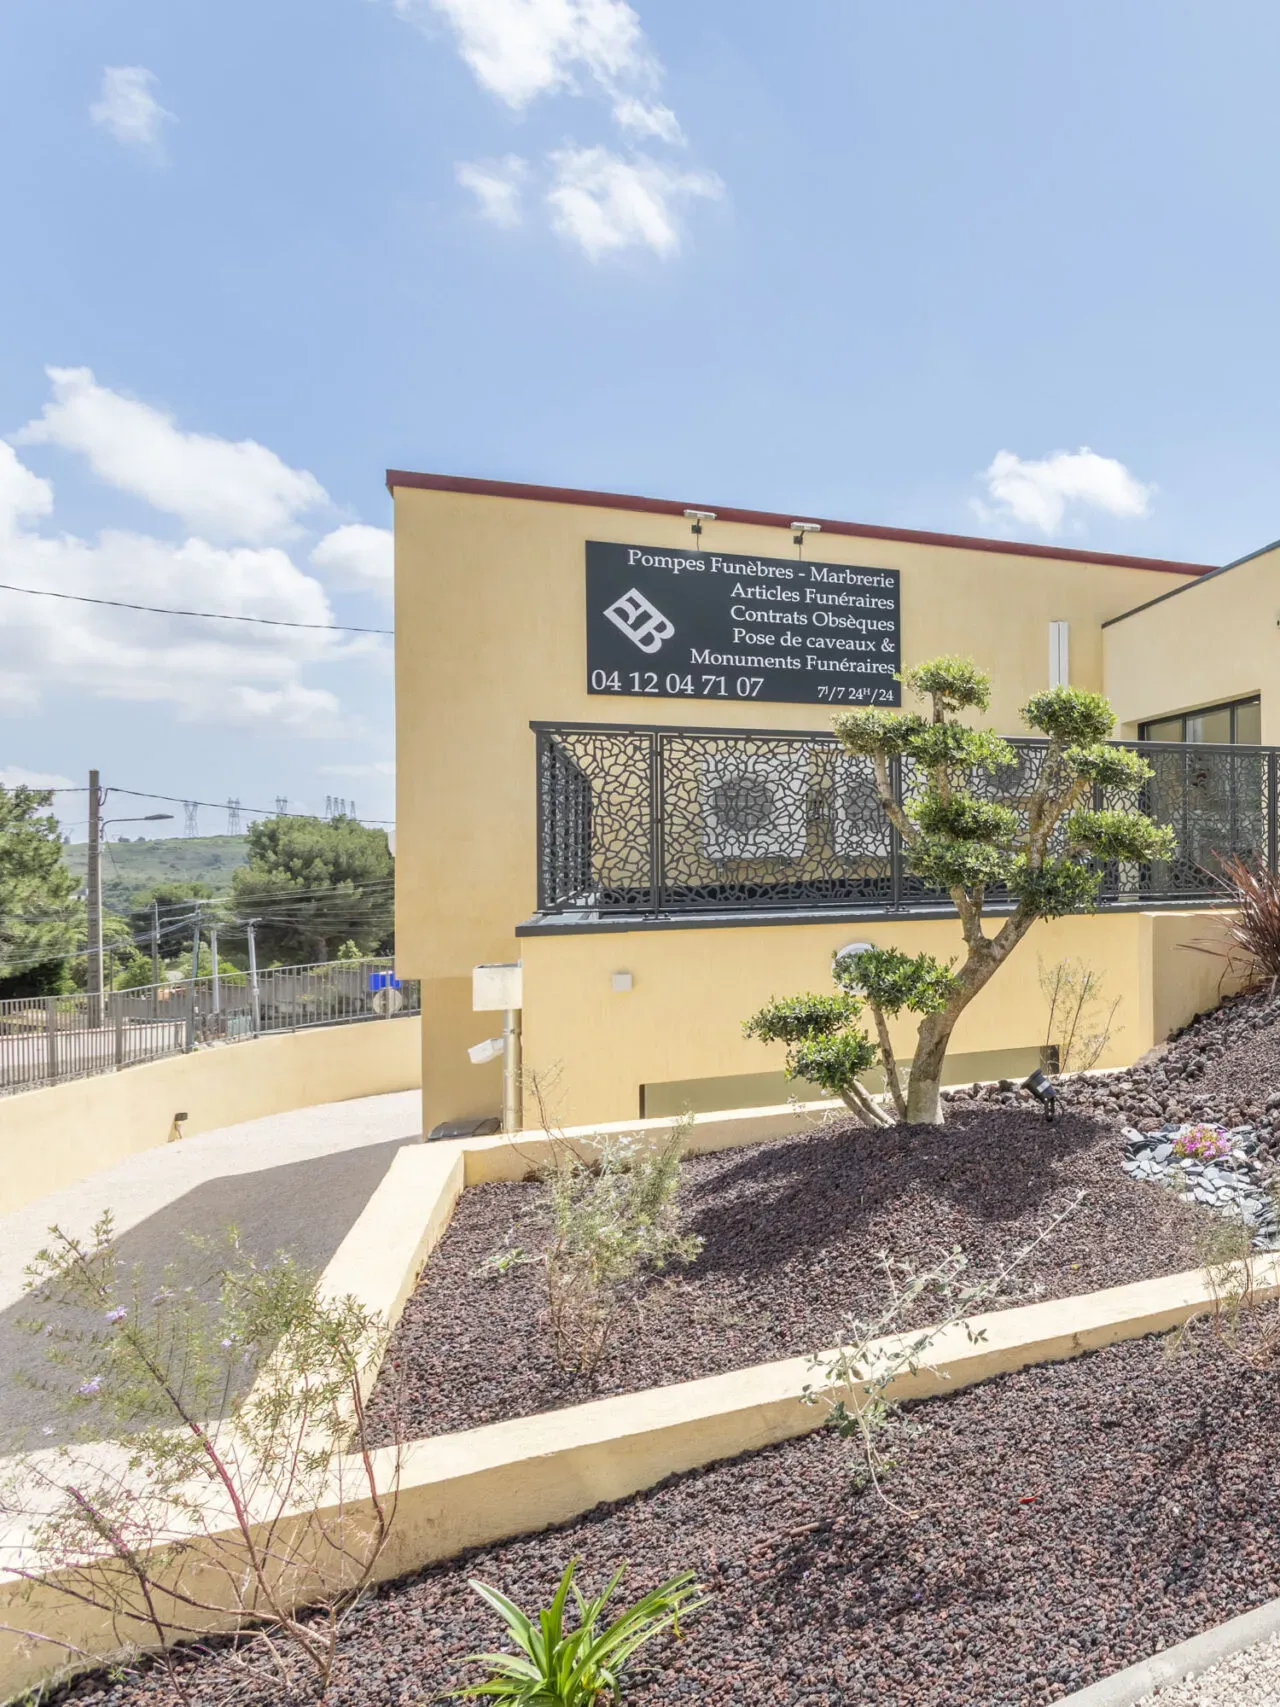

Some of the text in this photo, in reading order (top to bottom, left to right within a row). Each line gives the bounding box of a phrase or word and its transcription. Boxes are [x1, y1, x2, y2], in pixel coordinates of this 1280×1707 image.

[627, 549, 706, 575] Pompes
[710, 556, 794, 580] Funèbres
[809, 566, 895, 588] Marbrerie
[730, 581, 895, 610] Articles Funéraires
[730, 604, 895, 635] Contrats Obsèques
[732, 627, 896, 653] Pose de caveaux &
[689, 647, 896, 676] Monuments Funéraires
[591, 669, 765, 697] 04 12 04 71 07
